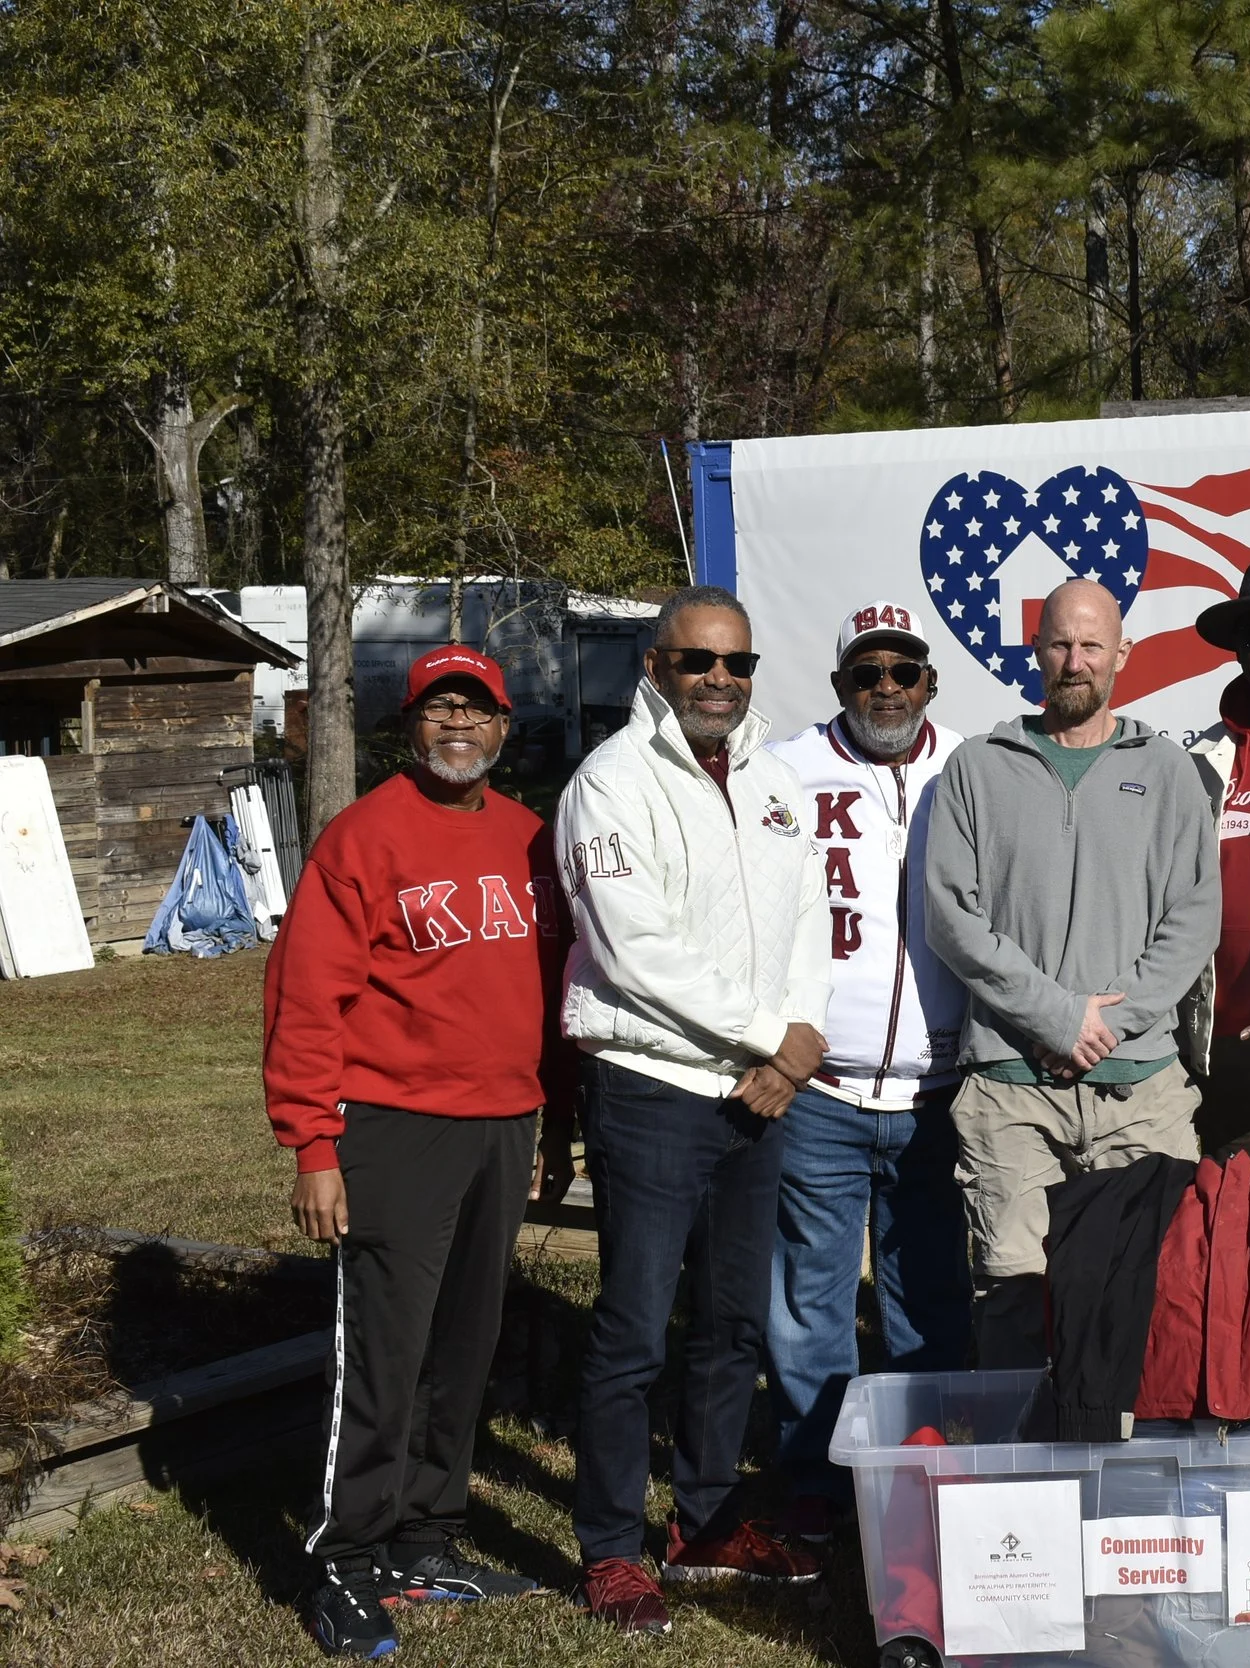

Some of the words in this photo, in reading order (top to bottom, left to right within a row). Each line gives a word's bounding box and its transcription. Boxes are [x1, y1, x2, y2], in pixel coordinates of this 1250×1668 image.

[852, 605, 911, 635] 1943
[450, 655, 476, 665] Alpha
[563, 832, 632, 898] 1911
[1100, 1536, 1205, 1556] Community
[1118, 1566, 1188, 1585] Service
